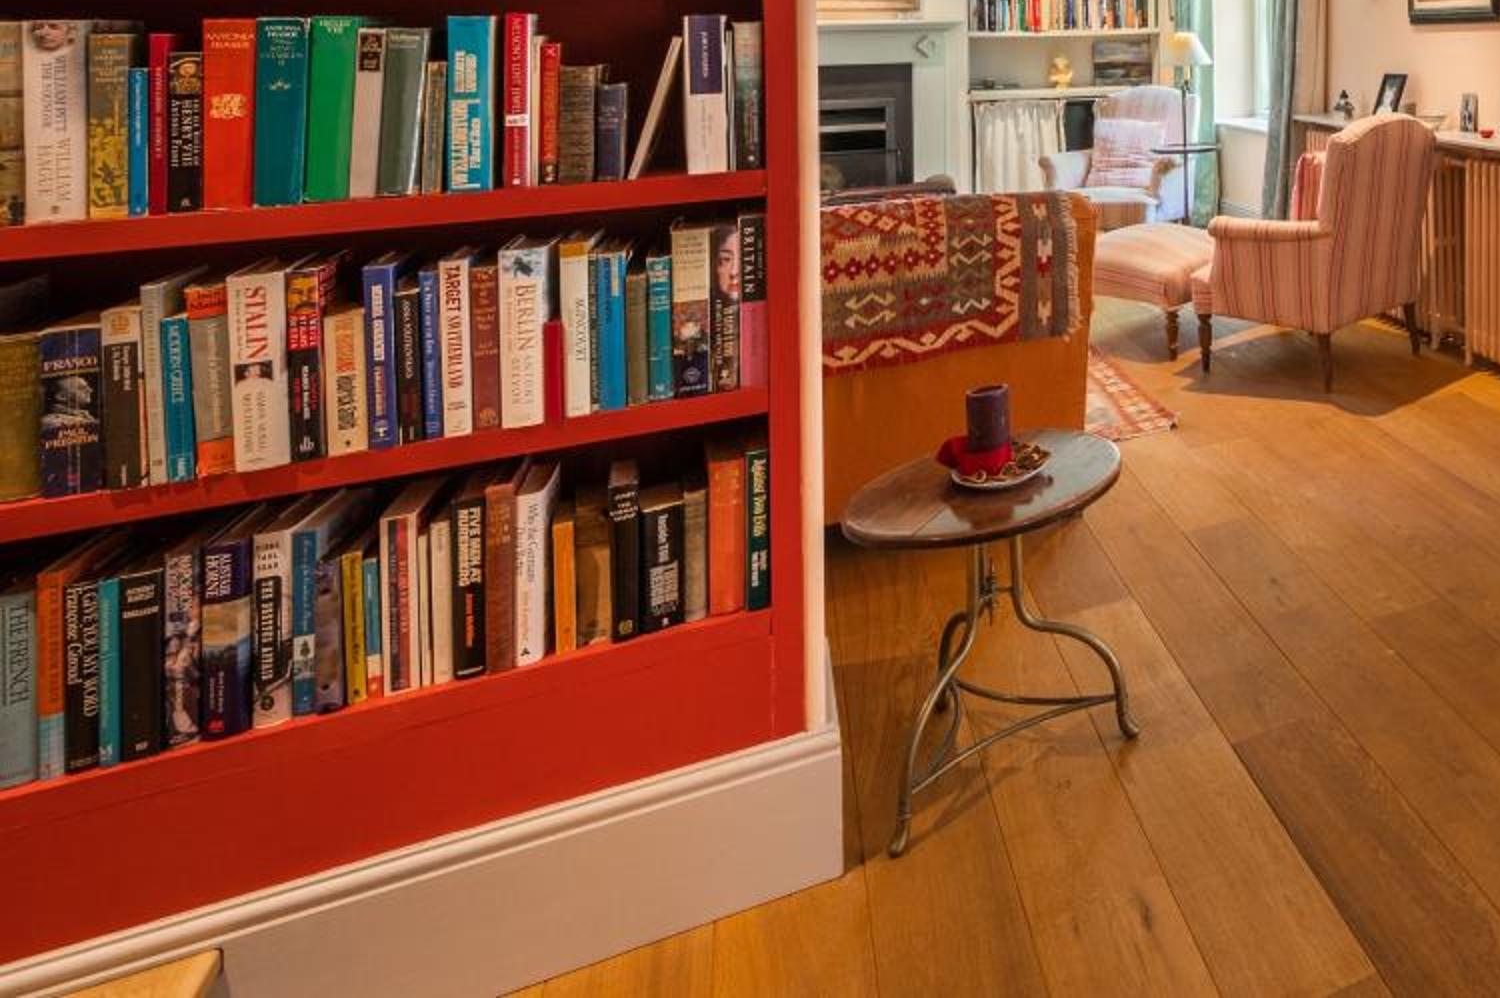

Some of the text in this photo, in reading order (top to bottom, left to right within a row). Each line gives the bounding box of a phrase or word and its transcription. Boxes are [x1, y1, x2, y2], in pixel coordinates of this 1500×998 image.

[181, 98, 193, 139] HENRY
[55, 138, 71, 201] WILLIAM
[743, 226, 755, 293] BRITAIN
[245, 287, 268, 359] STALIN
[445, 265, 464, 389] TARGET SWITZERLAND
[514, 283, 537, 351] BERLIN
[752, 459, 767, 493] Against
[469, 507, 481, 536] FIVE
[458, 509, 470, 587] NUREMBERG
[469, 537, 481, 565] MEN
[206, 554, 220, 599] HORNE
[469, 567, 481, 583] AT
[83, 591, 98, 623] GIVE
[9, 601, 29, 705] THE FRENCH
[83, 624, 98, 650] YOU
[83, 655, 98, 675] MY
[83, 677, 98, 716] WORD
